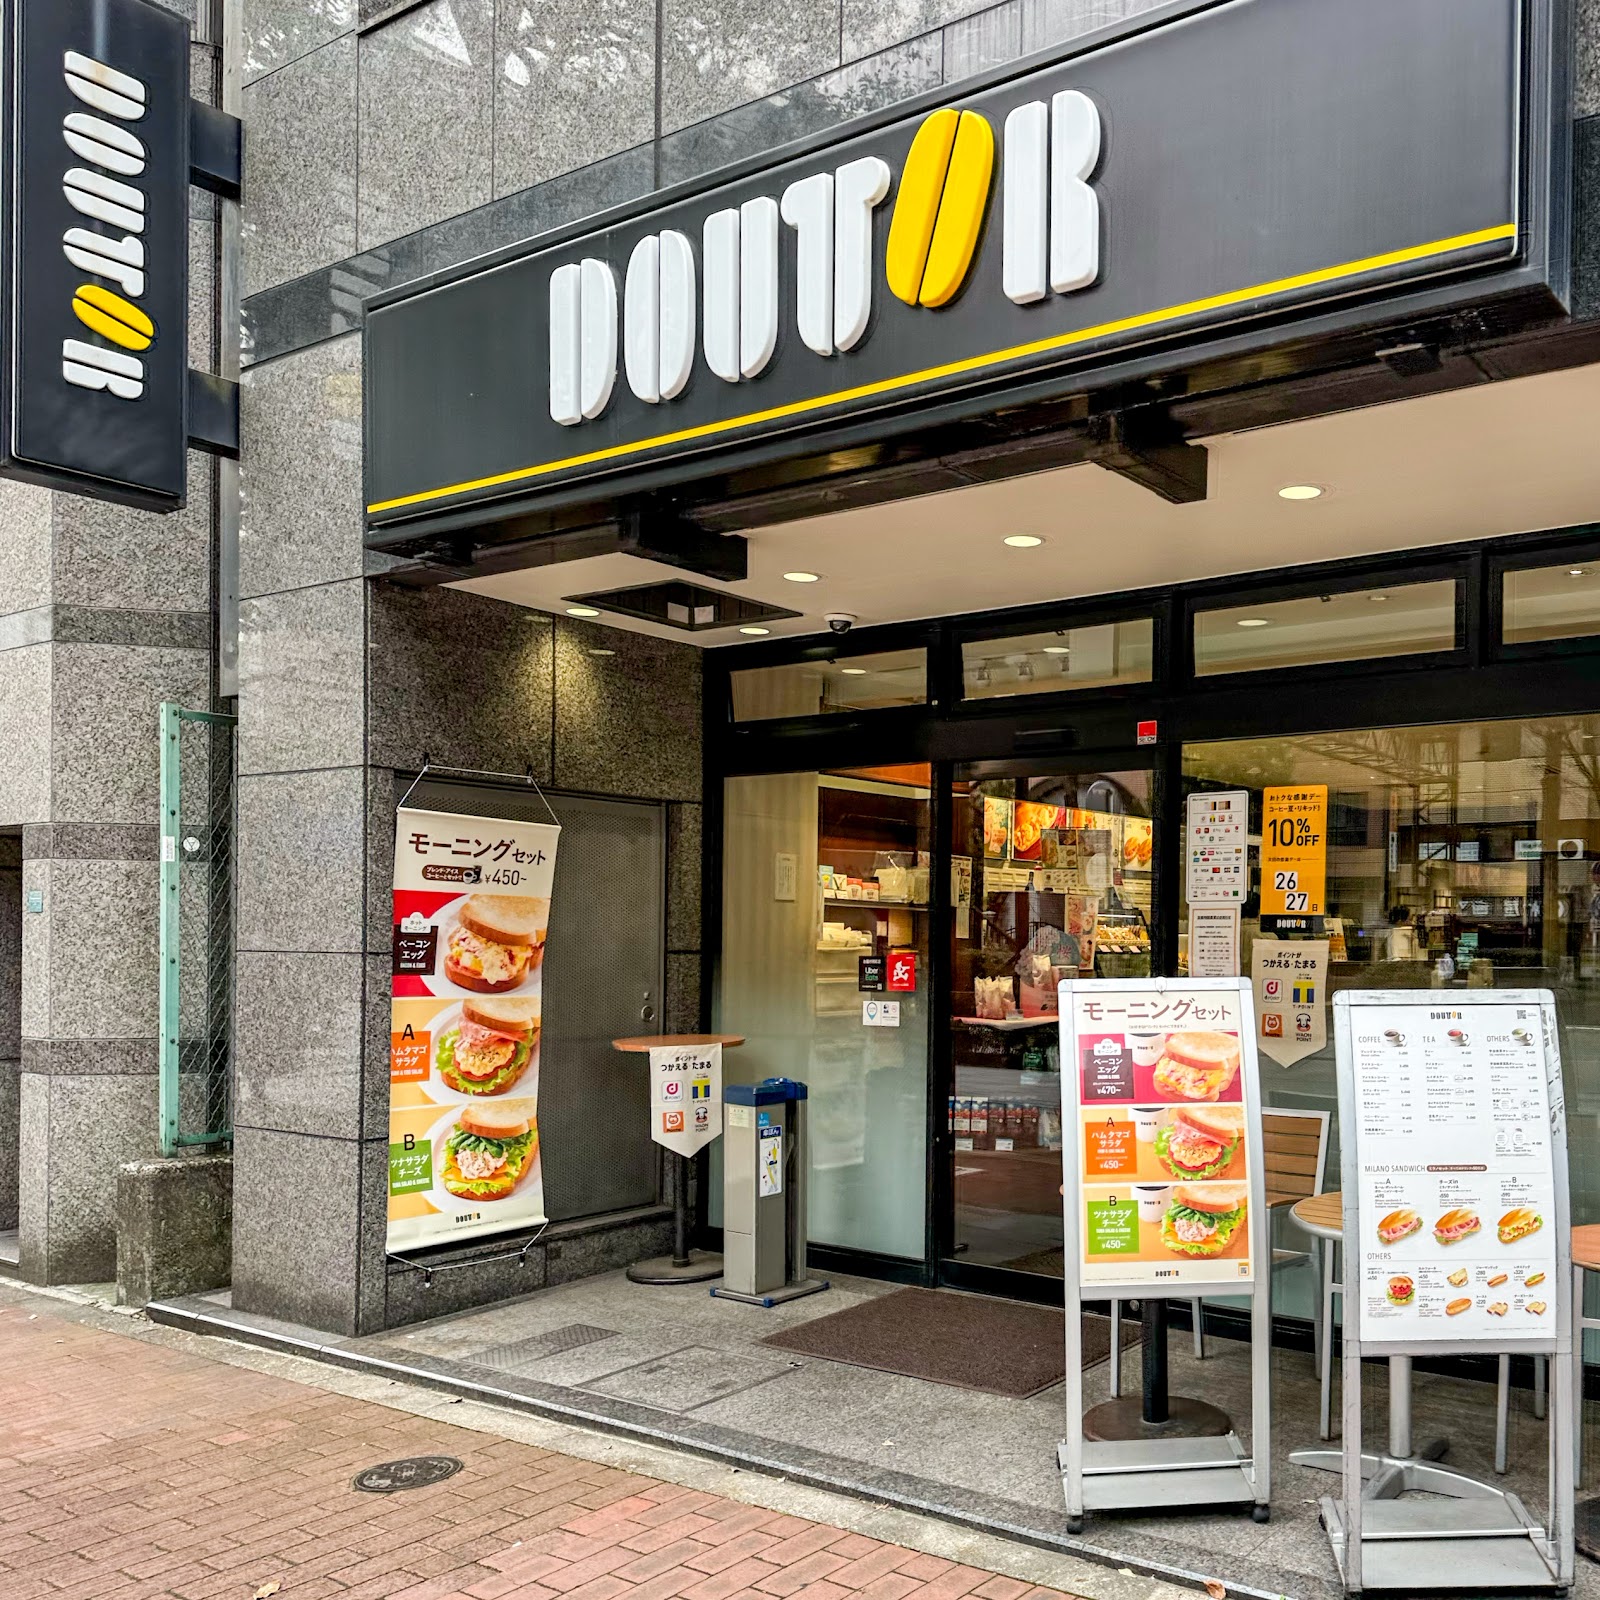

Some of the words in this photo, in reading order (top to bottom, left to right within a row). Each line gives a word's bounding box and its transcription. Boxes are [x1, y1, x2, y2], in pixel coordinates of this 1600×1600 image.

[63, 50, 155, 400] DOUTOR
[549, 90, 1101, 425] DOUTOR
[1296, 835, 1320, 846] OFF
[409, 833, 546, 866] モーニングセット
[1275, 872, 1296, 890] 26
[1286, 893, 1307, 910] 27
[1312, 904, 1318, 912] 日
[1276, 918, 1306, 928] DOUTOR
[399, 940, 431, 948] ベーコン
[402, 950, 427, 960] エッグ
[1083, 998, 1232, 1021] モーニングセット
[1430, 1011, 1462, 1020] DOUTOR
[401, 1024, 415, 1041] A
[394, 1056, 419, 1067] サラダ
[1097, 1065, 1120, 1074] エッグ
[1106, 1117, 1115, 1127] A
[1091, 1130, 1131, 1139] ハムタマゴ
[404, 1134, 416, 1151] B
[1099, 1139, 1123, 1148] サラダ
[390, 1154, 430, 1168] ツナサラダ
[398, 1165, 423, 1178] チーズ
[1109, 1196, 1117, 1206] B
[1093, 1209, 1132, 1219] ツナサラダ
[1102, 1218, 1126, 1227] チーズ
[1367, 1252, 1392, 1260] OTHERS
